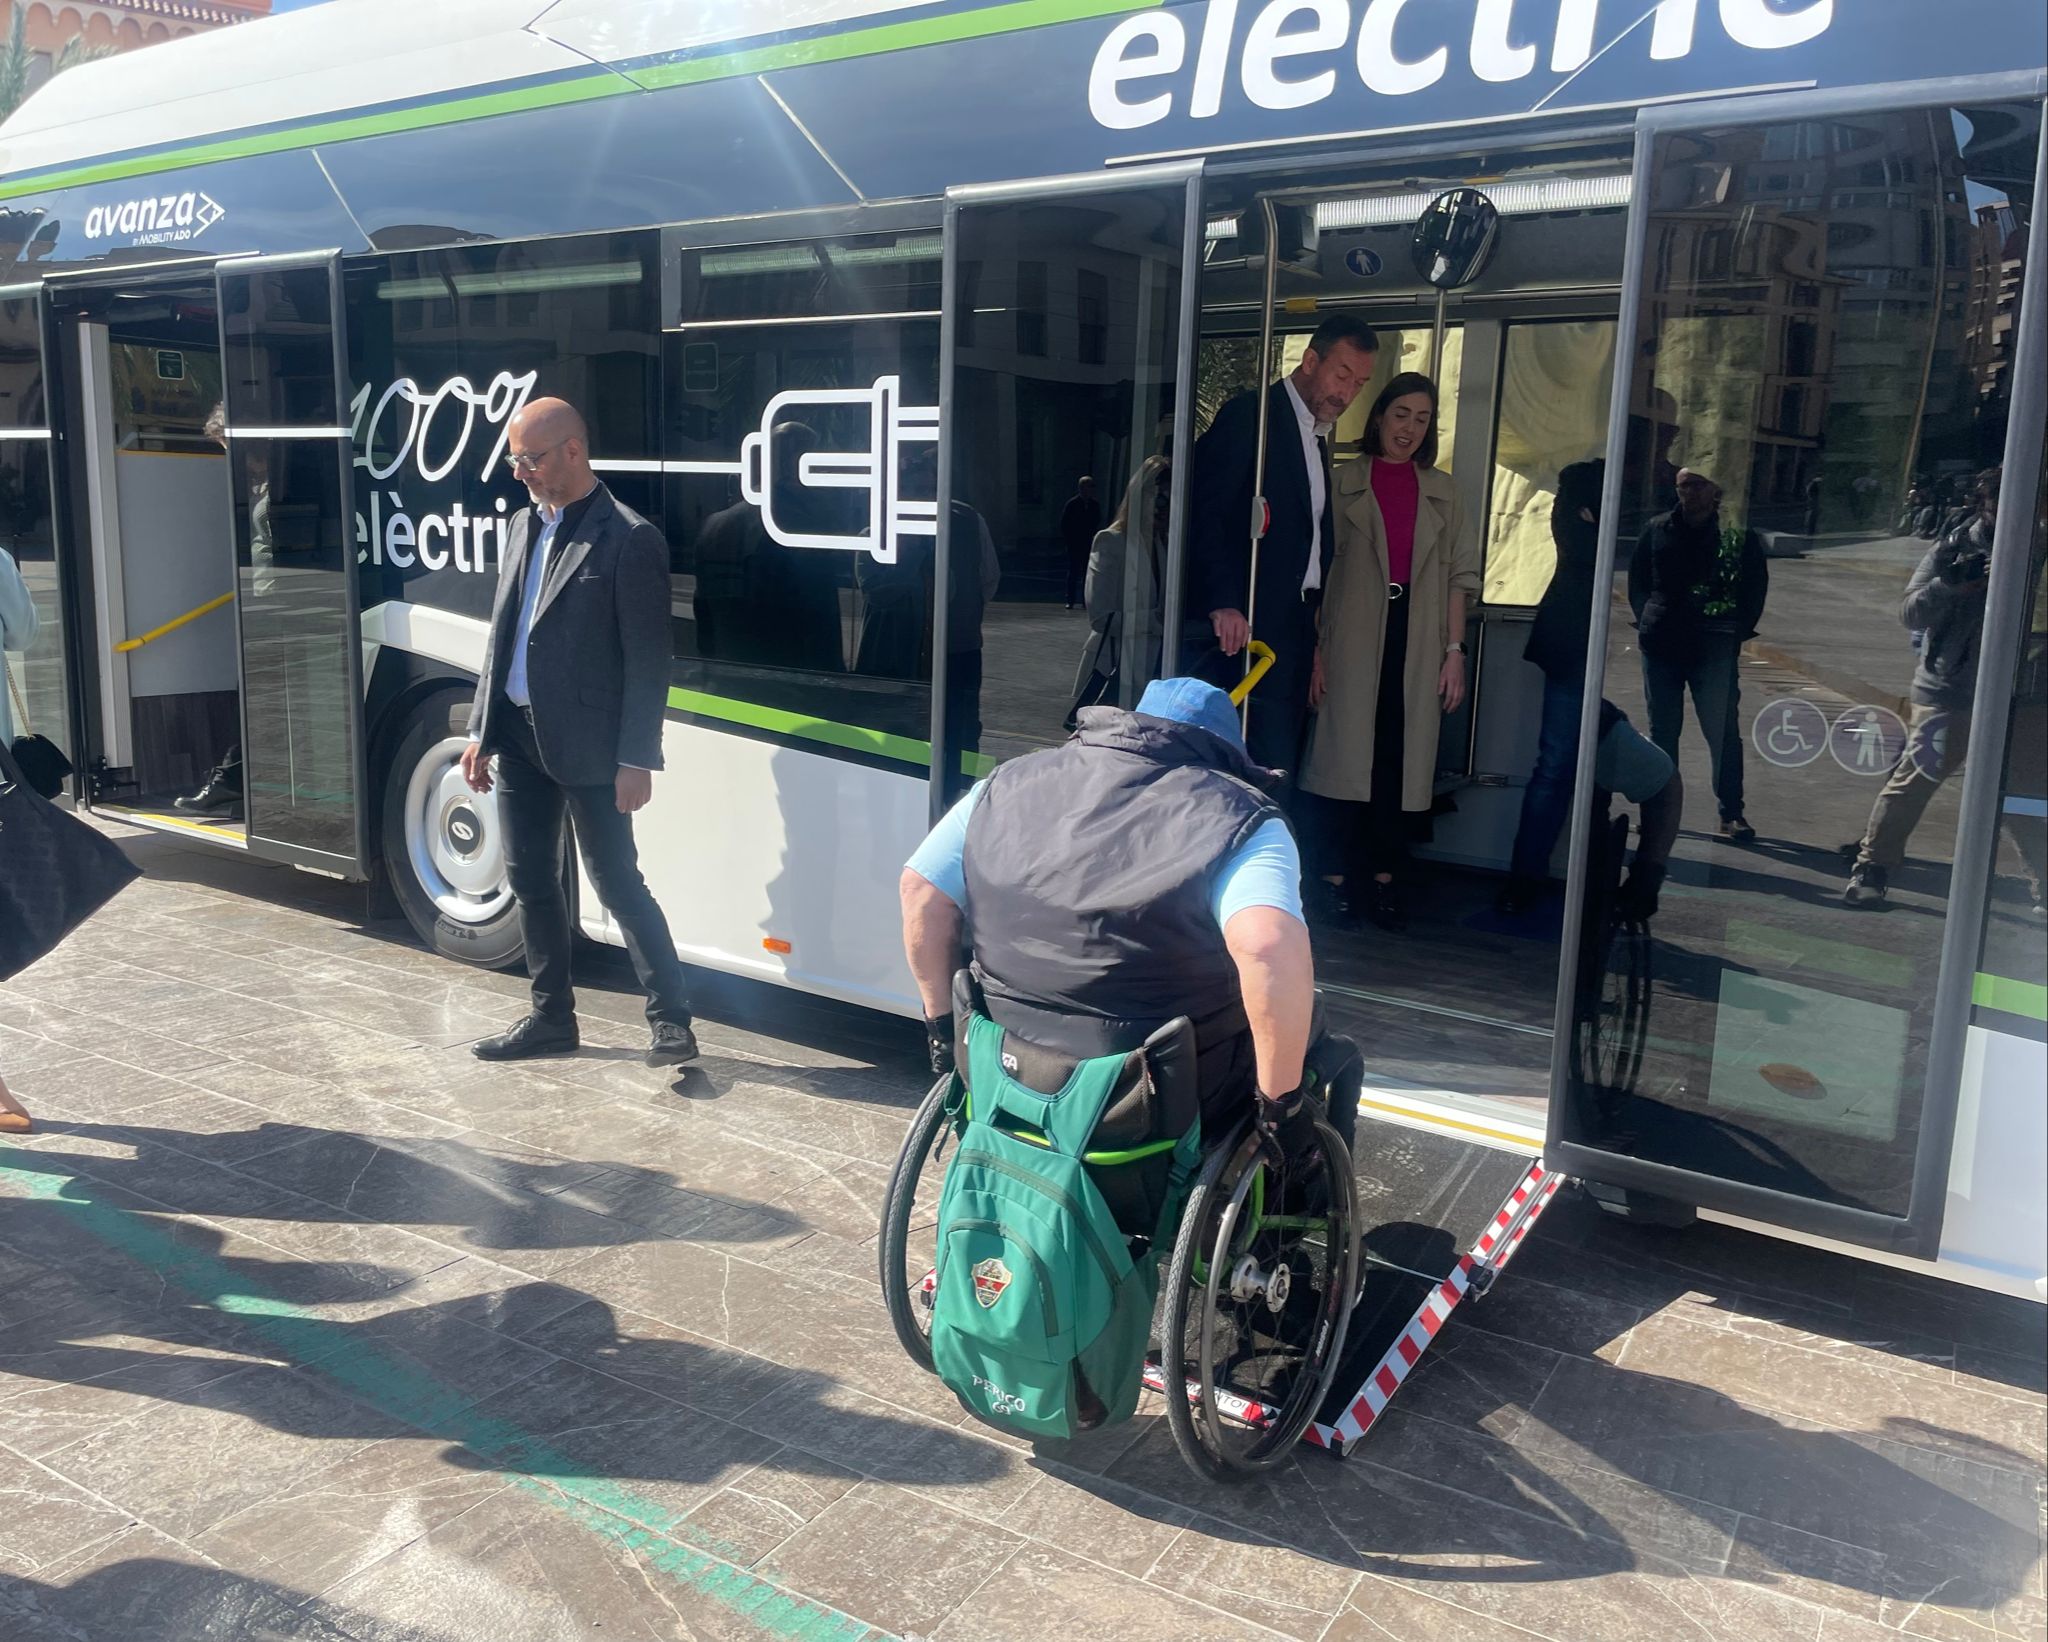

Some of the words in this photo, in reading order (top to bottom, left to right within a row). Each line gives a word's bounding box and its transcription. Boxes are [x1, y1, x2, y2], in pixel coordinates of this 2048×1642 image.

[84, 192, 197, 239] avanza
[138, 231, 174, 245] MOBILITY
[174, 229, 191, 240] ADO
[350, 370, 537, 483] 100%
[355, 490, 507, 574] lèctri
[972, 1374, 1025, 1412] PERICO
